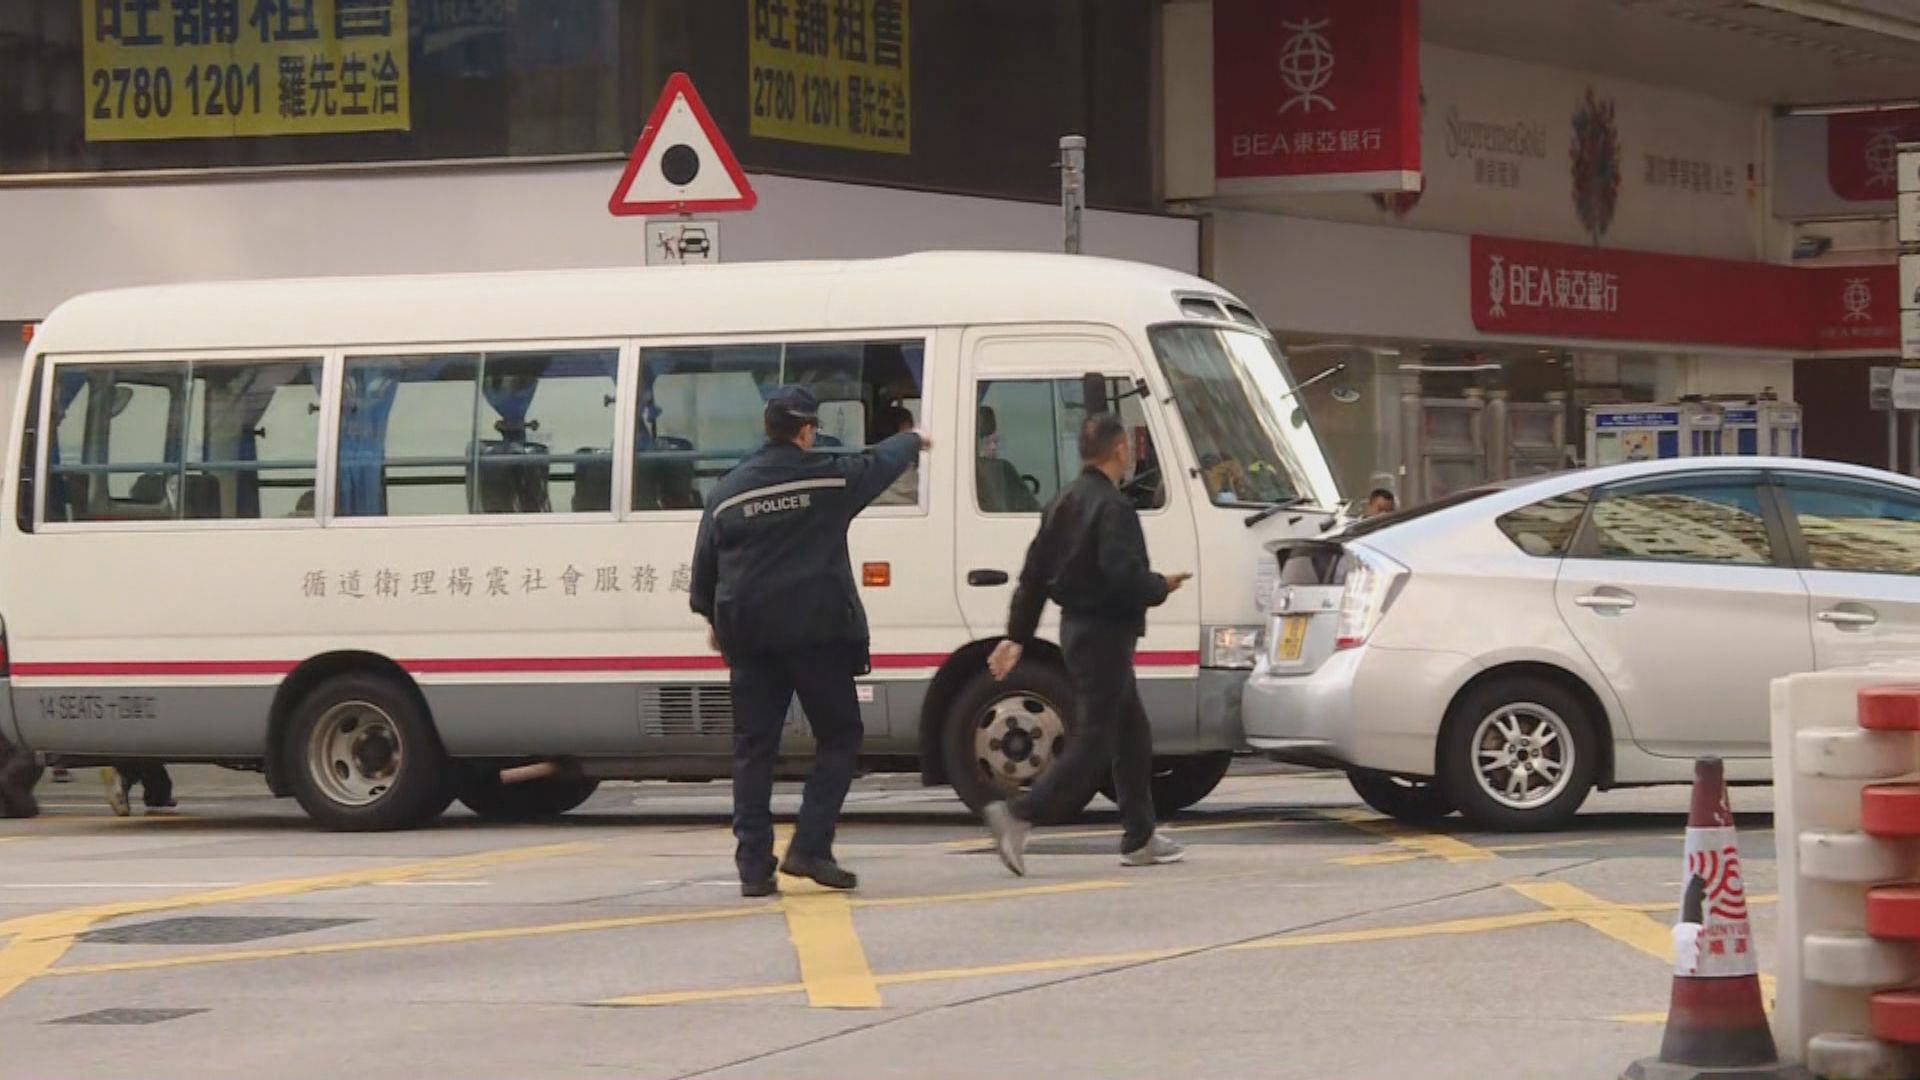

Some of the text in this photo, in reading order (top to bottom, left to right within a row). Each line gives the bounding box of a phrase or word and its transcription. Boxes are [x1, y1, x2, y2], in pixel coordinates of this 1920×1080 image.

[92, 50, 399, 119] 2780 1201 羅先生洽
[754, 66, 796, 121] 2780
[803, 74, 840, 128] 1201
[1232, 128, 1382, 156] BEA 東亞銀行
[1509, 264, 1619, 312] BEA 東亞銀行
[753, 495, 800, 514] POLICE
[39, 696, 55, 719] 14
[60, 695, 104, 719] SEATS
